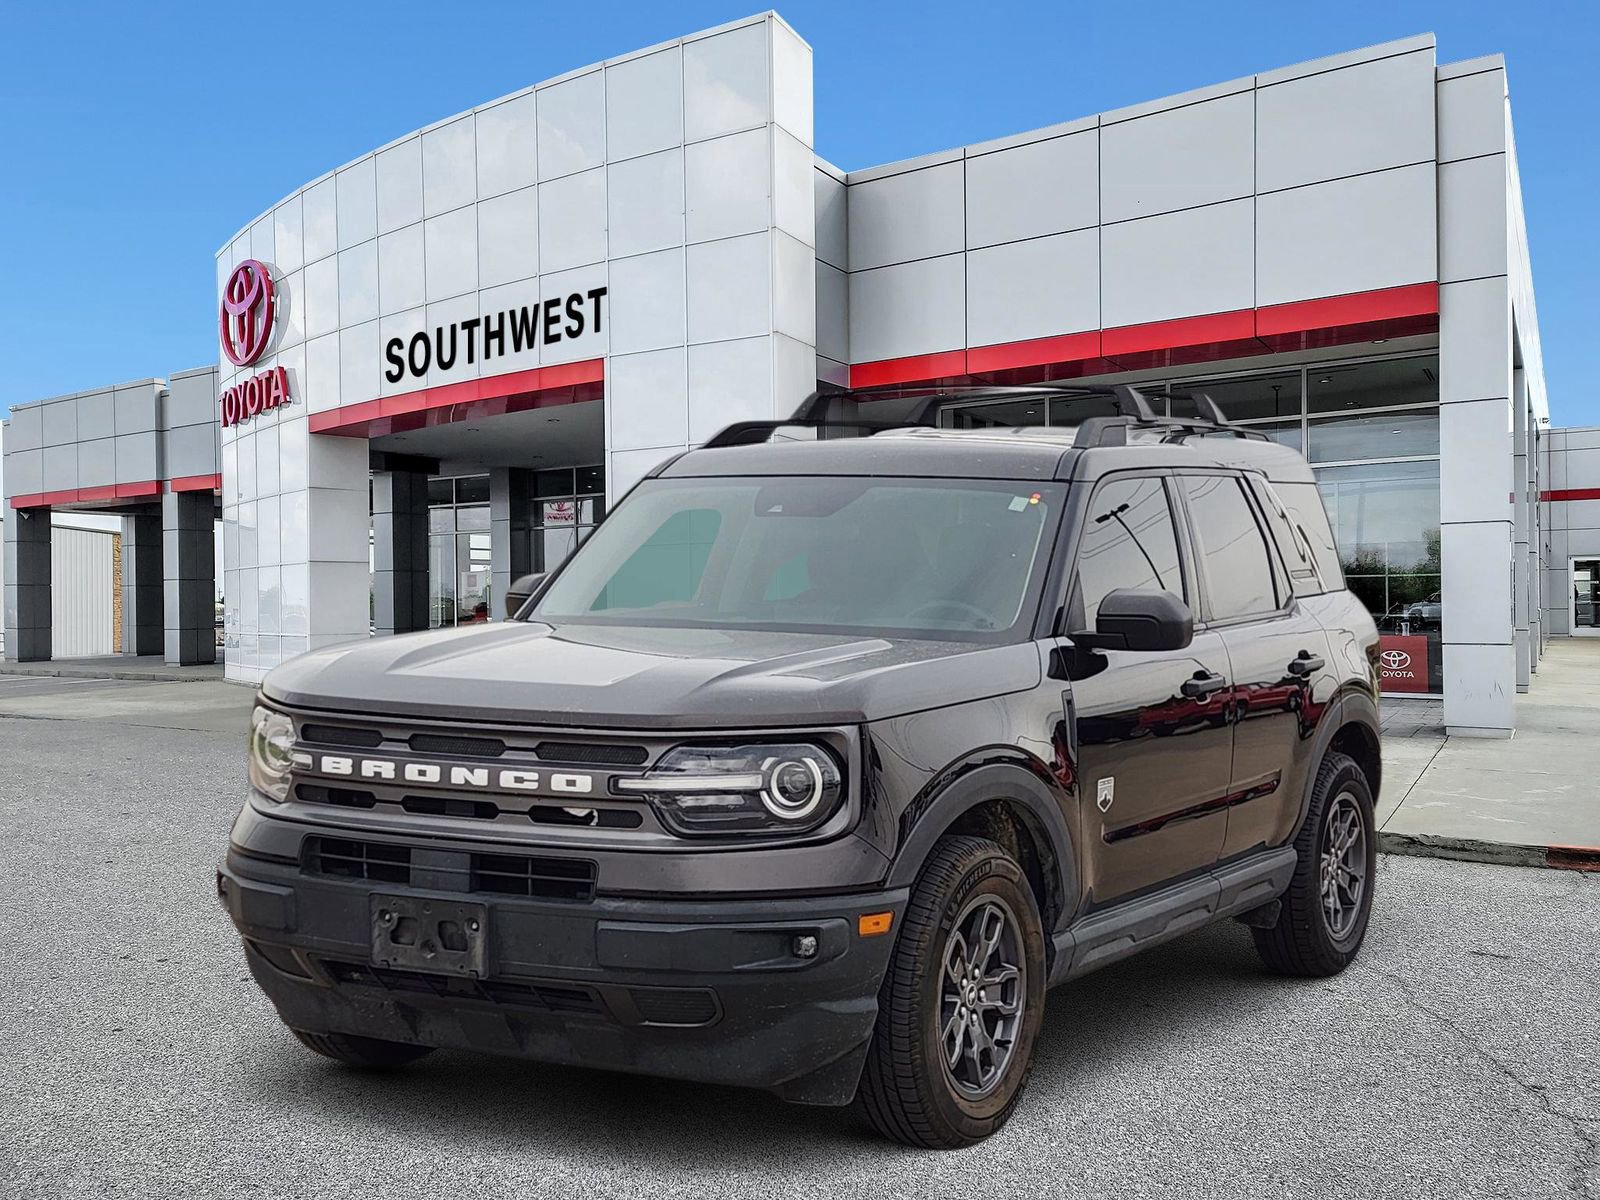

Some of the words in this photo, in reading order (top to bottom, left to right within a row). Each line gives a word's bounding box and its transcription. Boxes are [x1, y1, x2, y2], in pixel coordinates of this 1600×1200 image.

[385, 286, 608, 384] SOUTHWEST
[219, 366, 290, 427] TOYOTA
[1381, 670, 1415, 678] OYOTA
[321, 755, 593, 793] BRONCO
